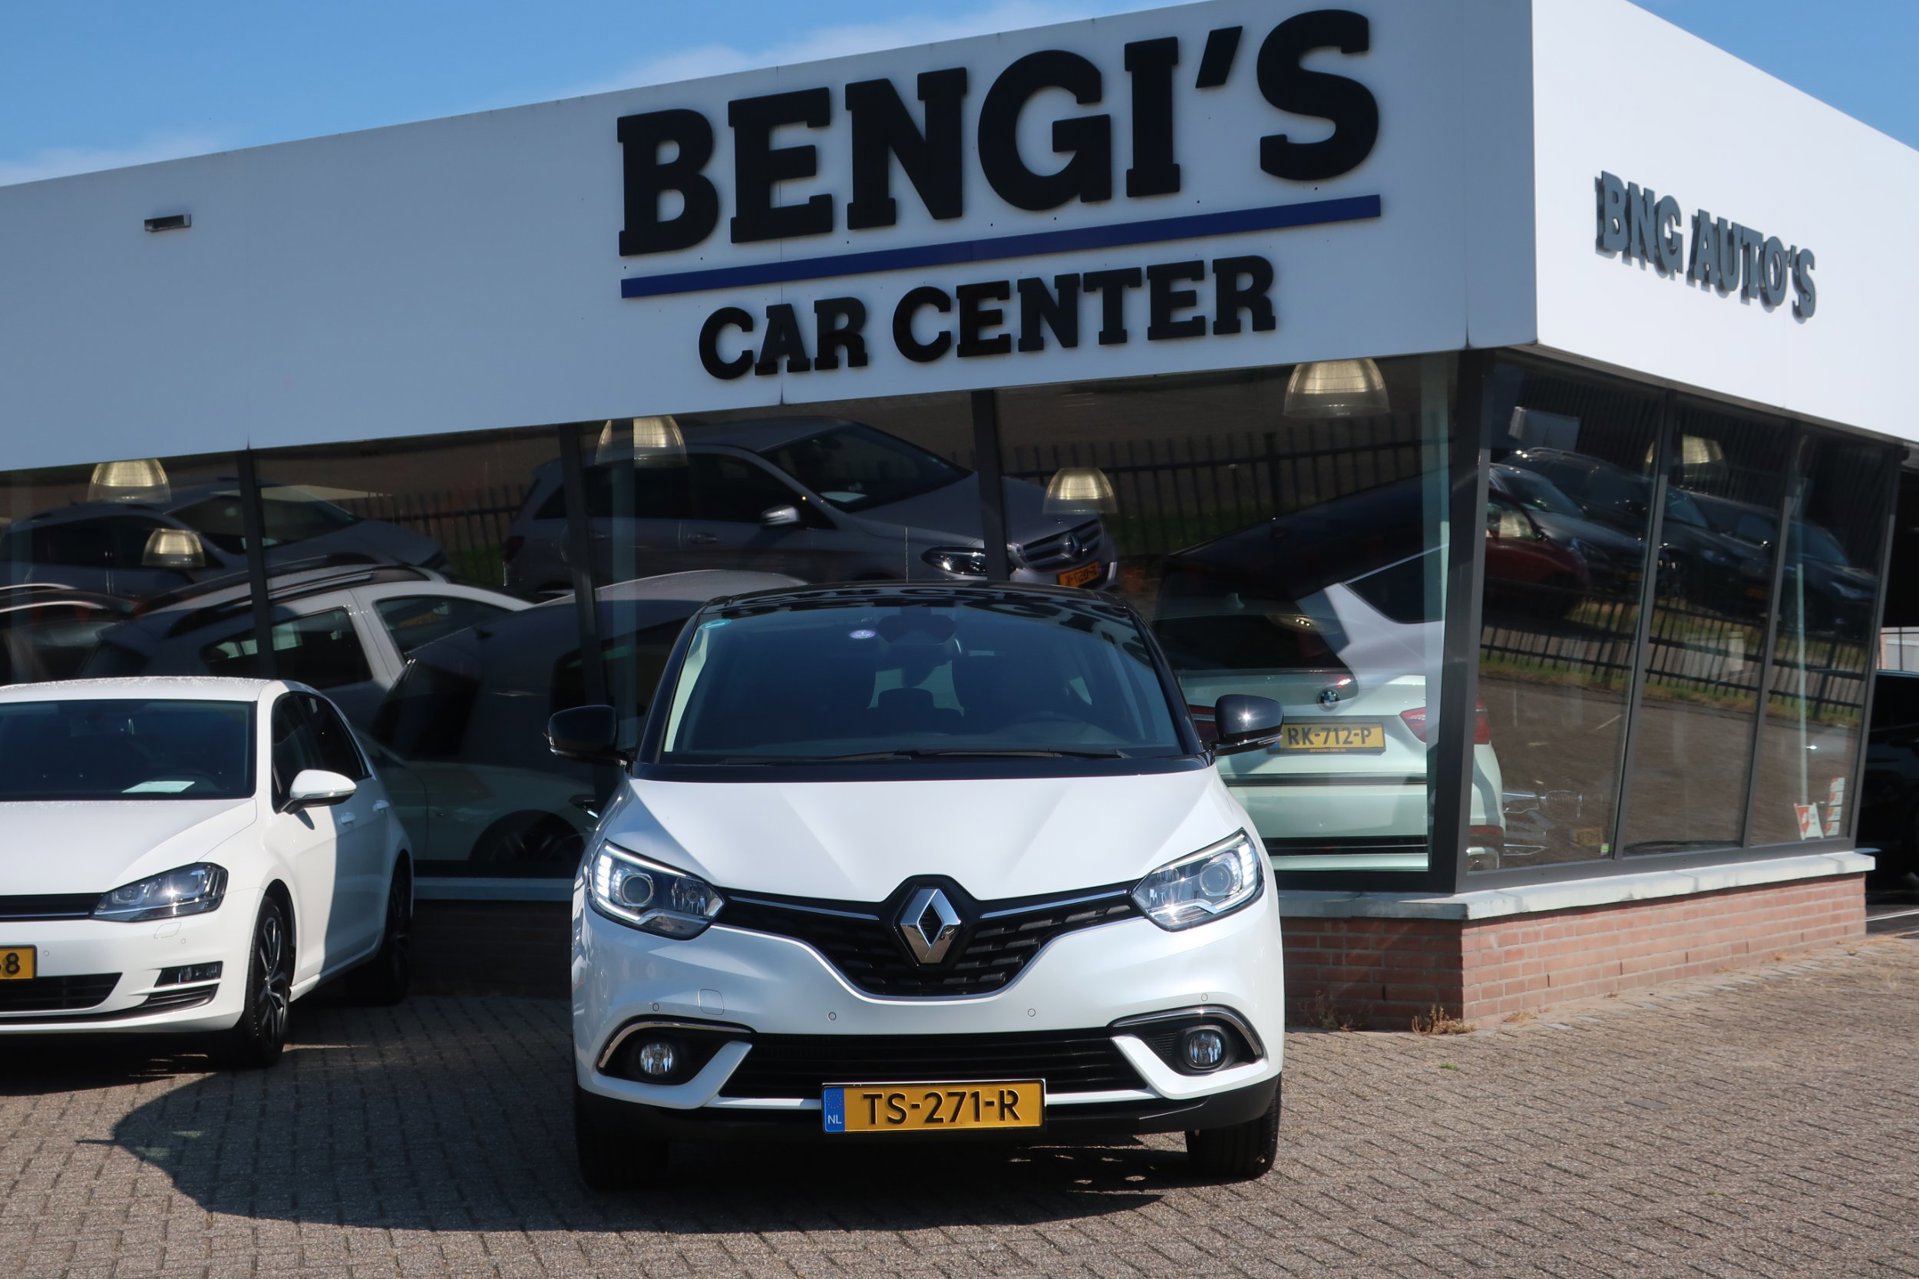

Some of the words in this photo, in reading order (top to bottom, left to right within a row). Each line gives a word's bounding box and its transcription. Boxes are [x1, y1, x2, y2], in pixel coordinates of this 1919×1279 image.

[617, 9, 1380, 257] BENGI'S
[1595, 170, 1684, 277] BNG
[1687, 208, 1817, 320] AUTO'S
[699, 296, 868, 381] CAR
[893, 255, 1276, 363] CENTER
[1287, 727, 1372, 746] RK-712-P
[0, 952, 20, 975] 8
[827, 1114, 842, 1125] NL
[863, 1089, 1021, 1125] TS-271-R
